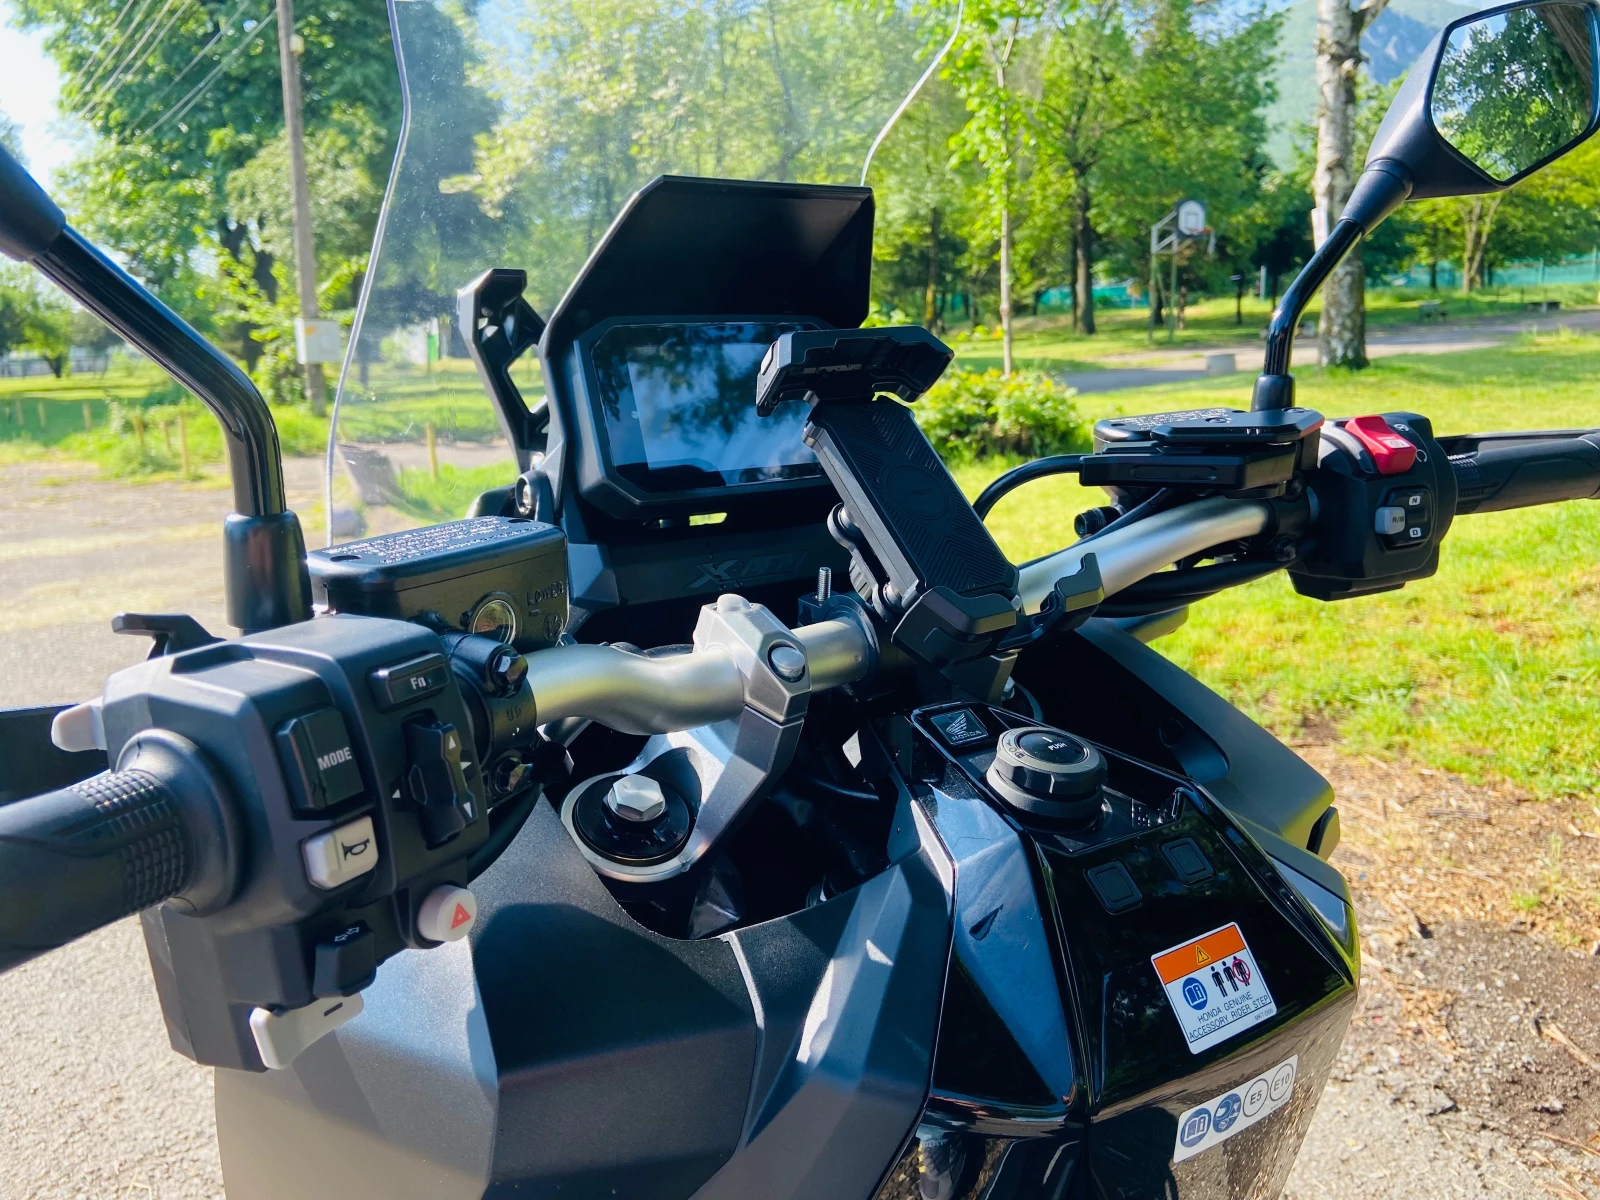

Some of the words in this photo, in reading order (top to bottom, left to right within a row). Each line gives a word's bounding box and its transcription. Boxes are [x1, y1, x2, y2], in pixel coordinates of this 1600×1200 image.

[526, 580, 564, 605] LOWER
[410, 676, 427, 690] Fn
[506, 705, 522, 721] UP
[951, 730, 982, 741] HONDA
[1047, 742, 1068, 751] PUSH
[317, 746, 353, 771] MODE
[1197, 1006, 1223, 1024] HONDA
[1223, 990, 1253, 1011] GENUINE
[1189, 1014, 1229, 1040] ACCESSORY
[1230, 1004, 1252, 1020] RIDER
[1252, 994, 1270, 1009] STEP
[1273, 1072, 1291, 1092] E10
[1249, 1089, 1263, 1106] E5
